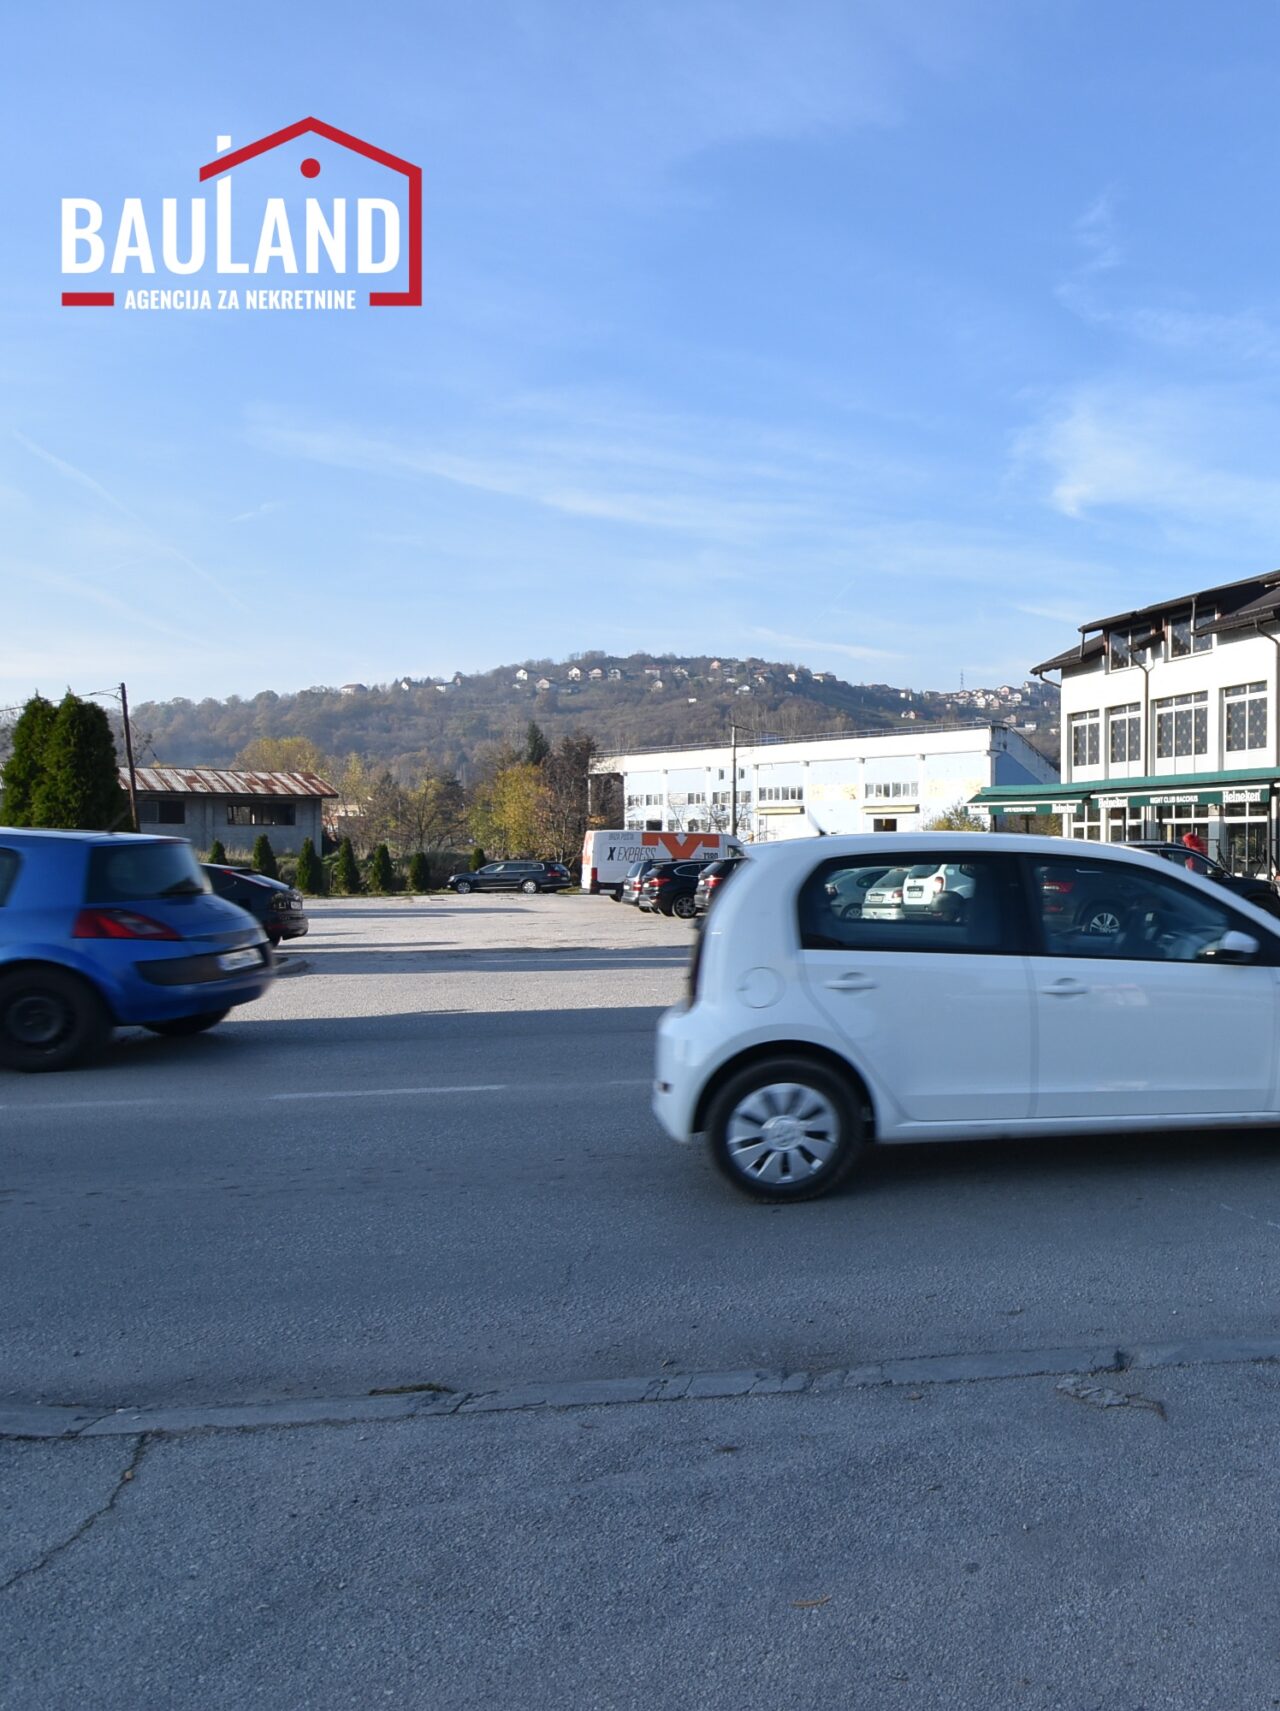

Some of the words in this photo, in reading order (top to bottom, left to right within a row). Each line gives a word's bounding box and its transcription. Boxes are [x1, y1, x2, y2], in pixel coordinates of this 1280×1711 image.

[1222, 790, 1261, 803] Heineken
[607, 846, 616, 860] X
[617, 847, 656, 860] EXPRESS
